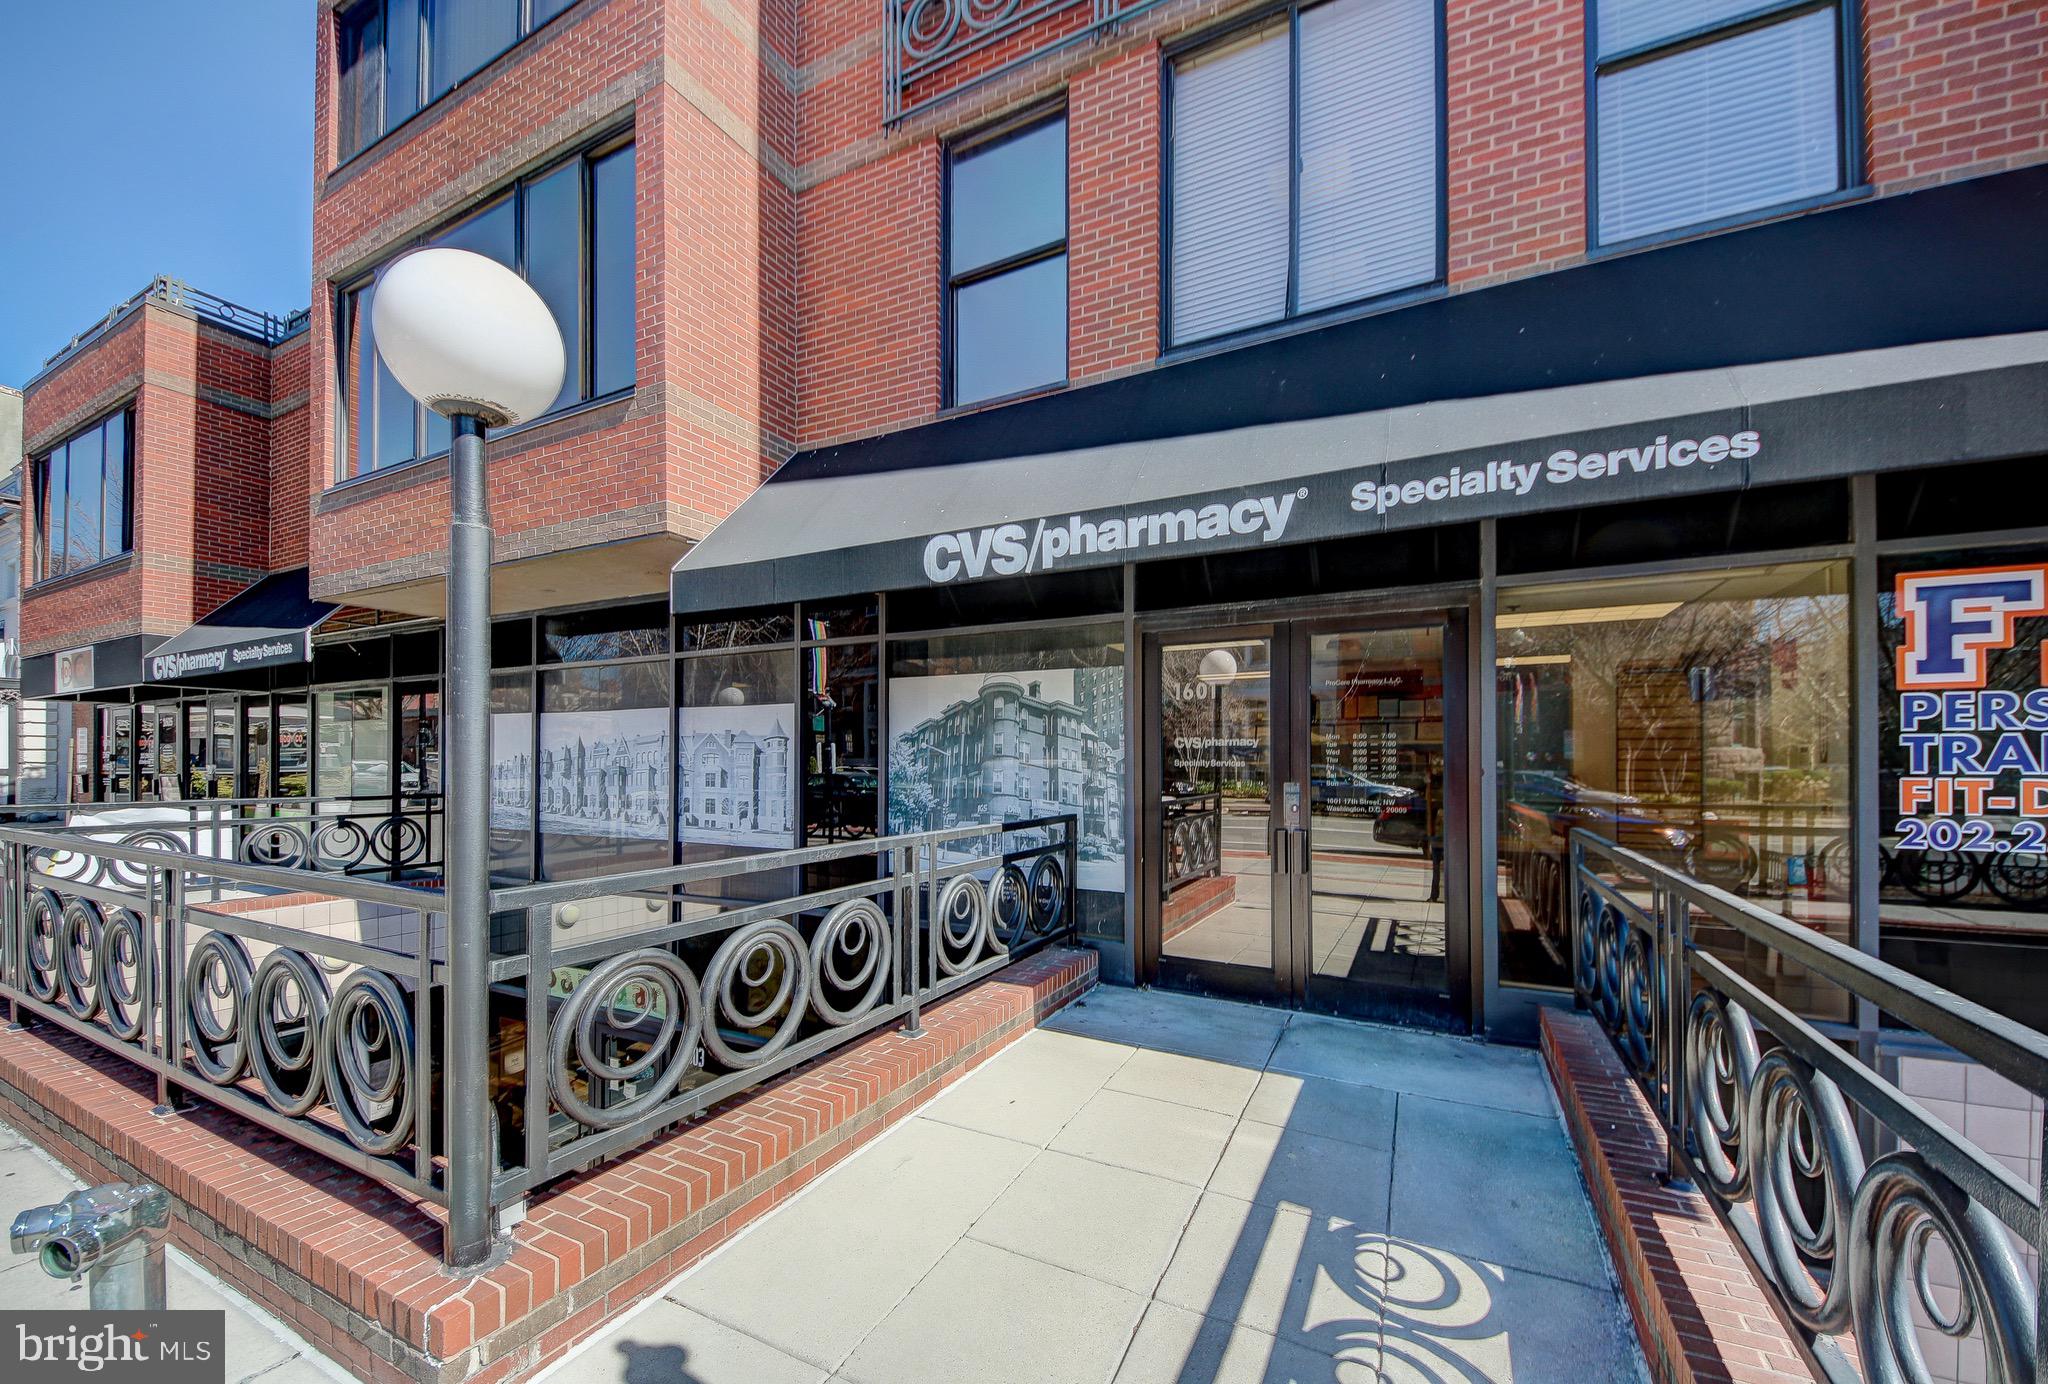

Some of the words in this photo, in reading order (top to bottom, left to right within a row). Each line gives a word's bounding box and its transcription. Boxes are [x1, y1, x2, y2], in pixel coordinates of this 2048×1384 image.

[1350, 460, 1542, 515] Specialty
[1545, 430, 1761, 484] Services
[232, 648, 263, 662] Specialty
[262, 641, 293, 657] Services
[1173, 682, 1216, 701] 1601
[1174, 736, 1259, 749] CVS/pharmacy
